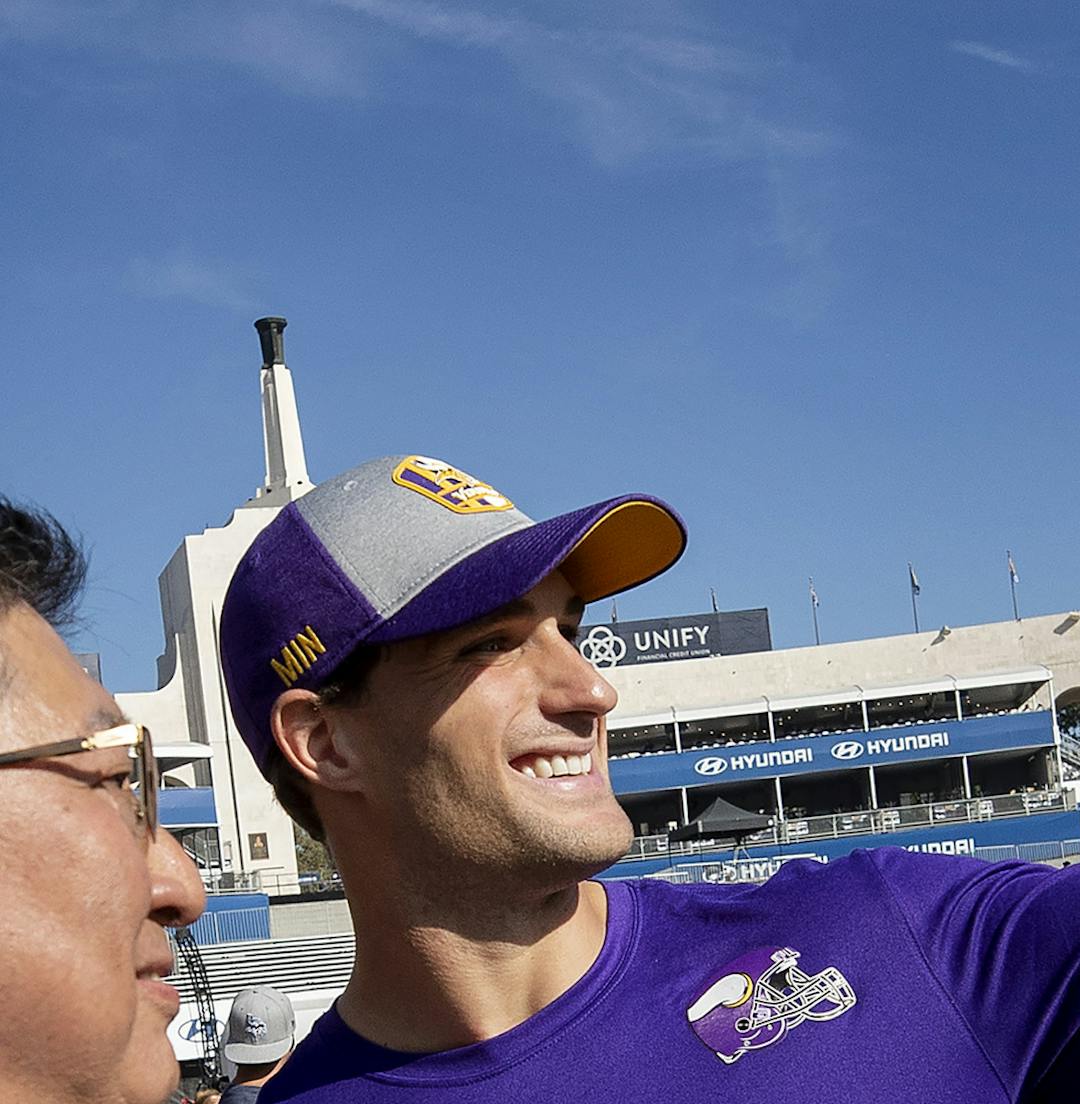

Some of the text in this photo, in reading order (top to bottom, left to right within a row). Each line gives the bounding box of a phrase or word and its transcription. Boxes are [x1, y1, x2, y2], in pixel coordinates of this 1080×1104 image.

[634, 625, 710, 651] UNIFY
[270, 625, 327, 688] MIN
[867, 732, 949, 756] HYUNDAI
[730, 748, 813, 770] HYUNDAI
